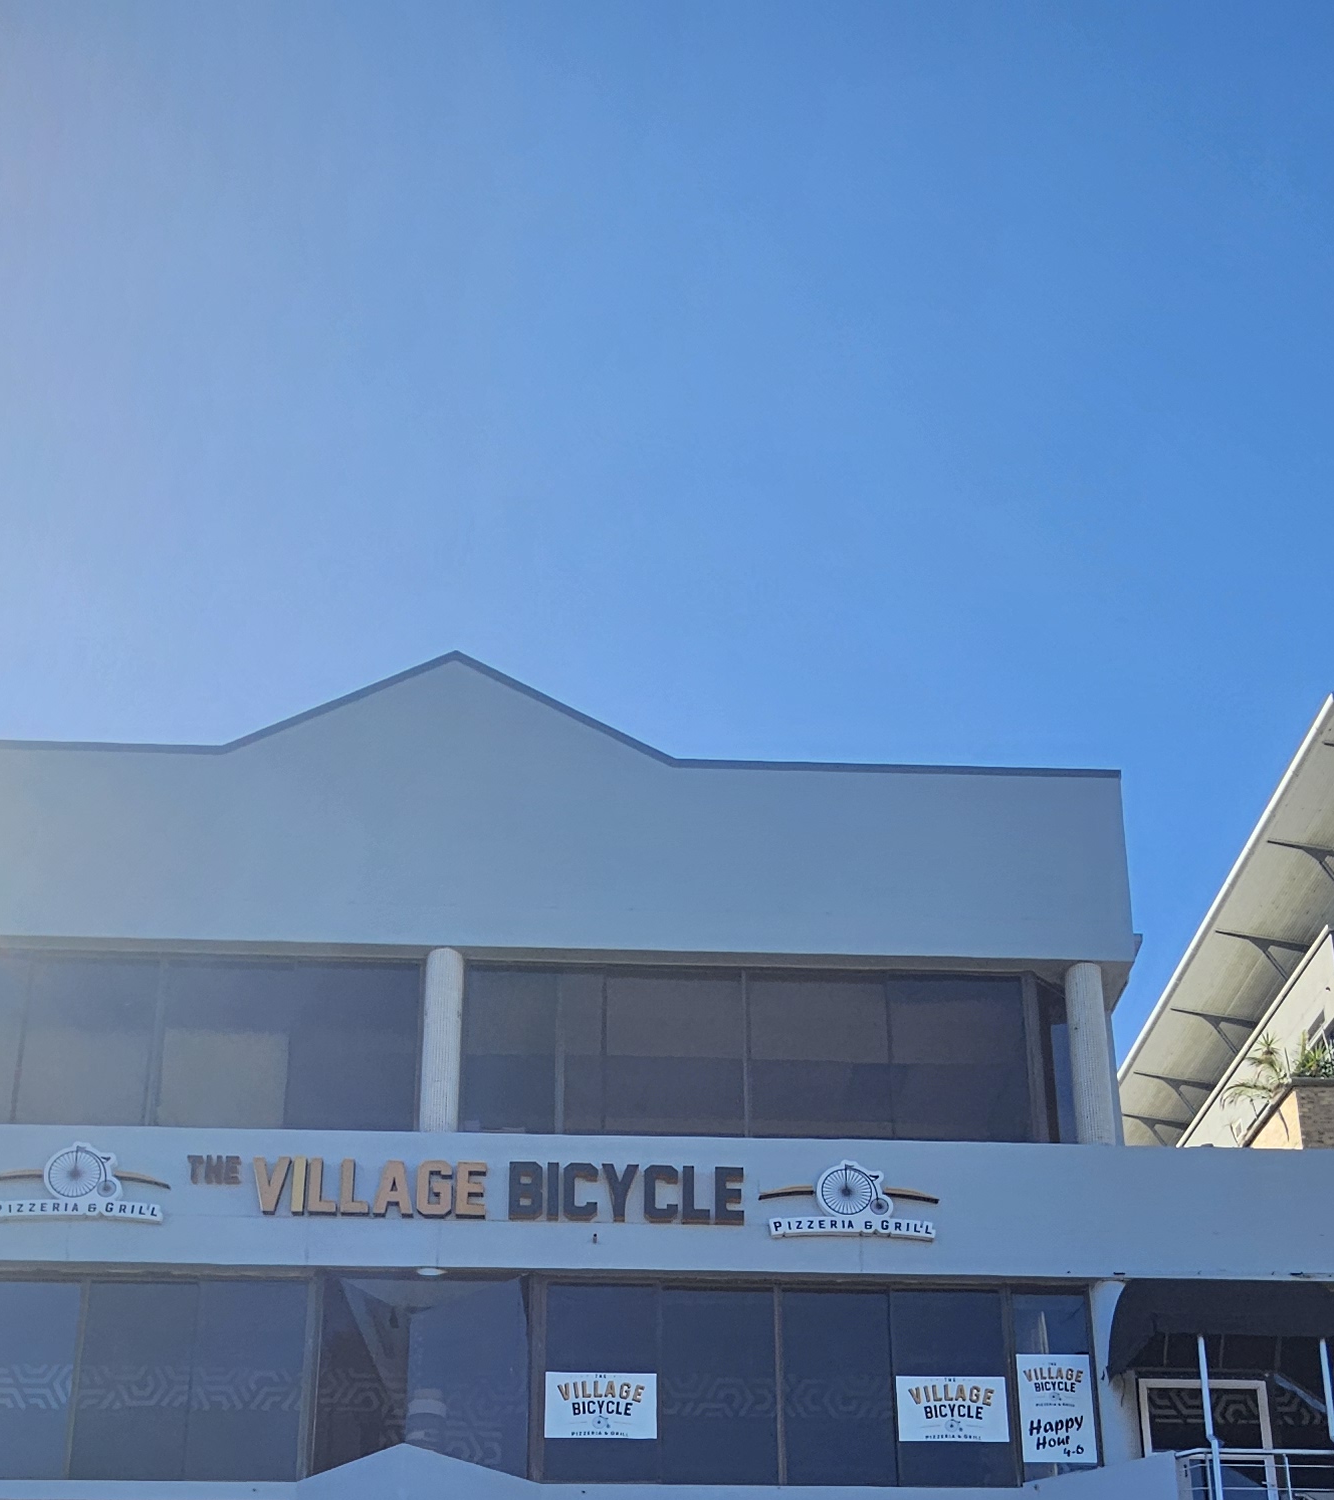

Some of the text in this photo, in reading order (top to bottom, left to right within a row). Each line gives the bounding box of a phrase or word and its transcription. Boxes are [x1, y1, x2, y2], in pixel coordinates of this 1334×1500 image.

[187, 1154, 745, 1225] THE VILLAGE BICYCLE
[105, 1202, 160, 1217] GRILL
[773, 1220, 854, 1231] PIZZERIA
[881, 1220, 933, 1235] GRILL
[1023, 1367, 1084, 1383] VILLAGE
[557, 1380, 645, 1403] VILLAGE
[908, 1384, 994, 1406] VILLAGE
[1034, 1381, 1076, 1393] BICYCLE
[572, 1400, 633, 1416] BICYCLE
[924, 1404, 983, 1420] BICYCLE
[1029, 1415, 1084, 1436] Happy
[1036, 1435, 1070, 1450] Hour
[1063, 1444, 1085, 1457] 4-6
